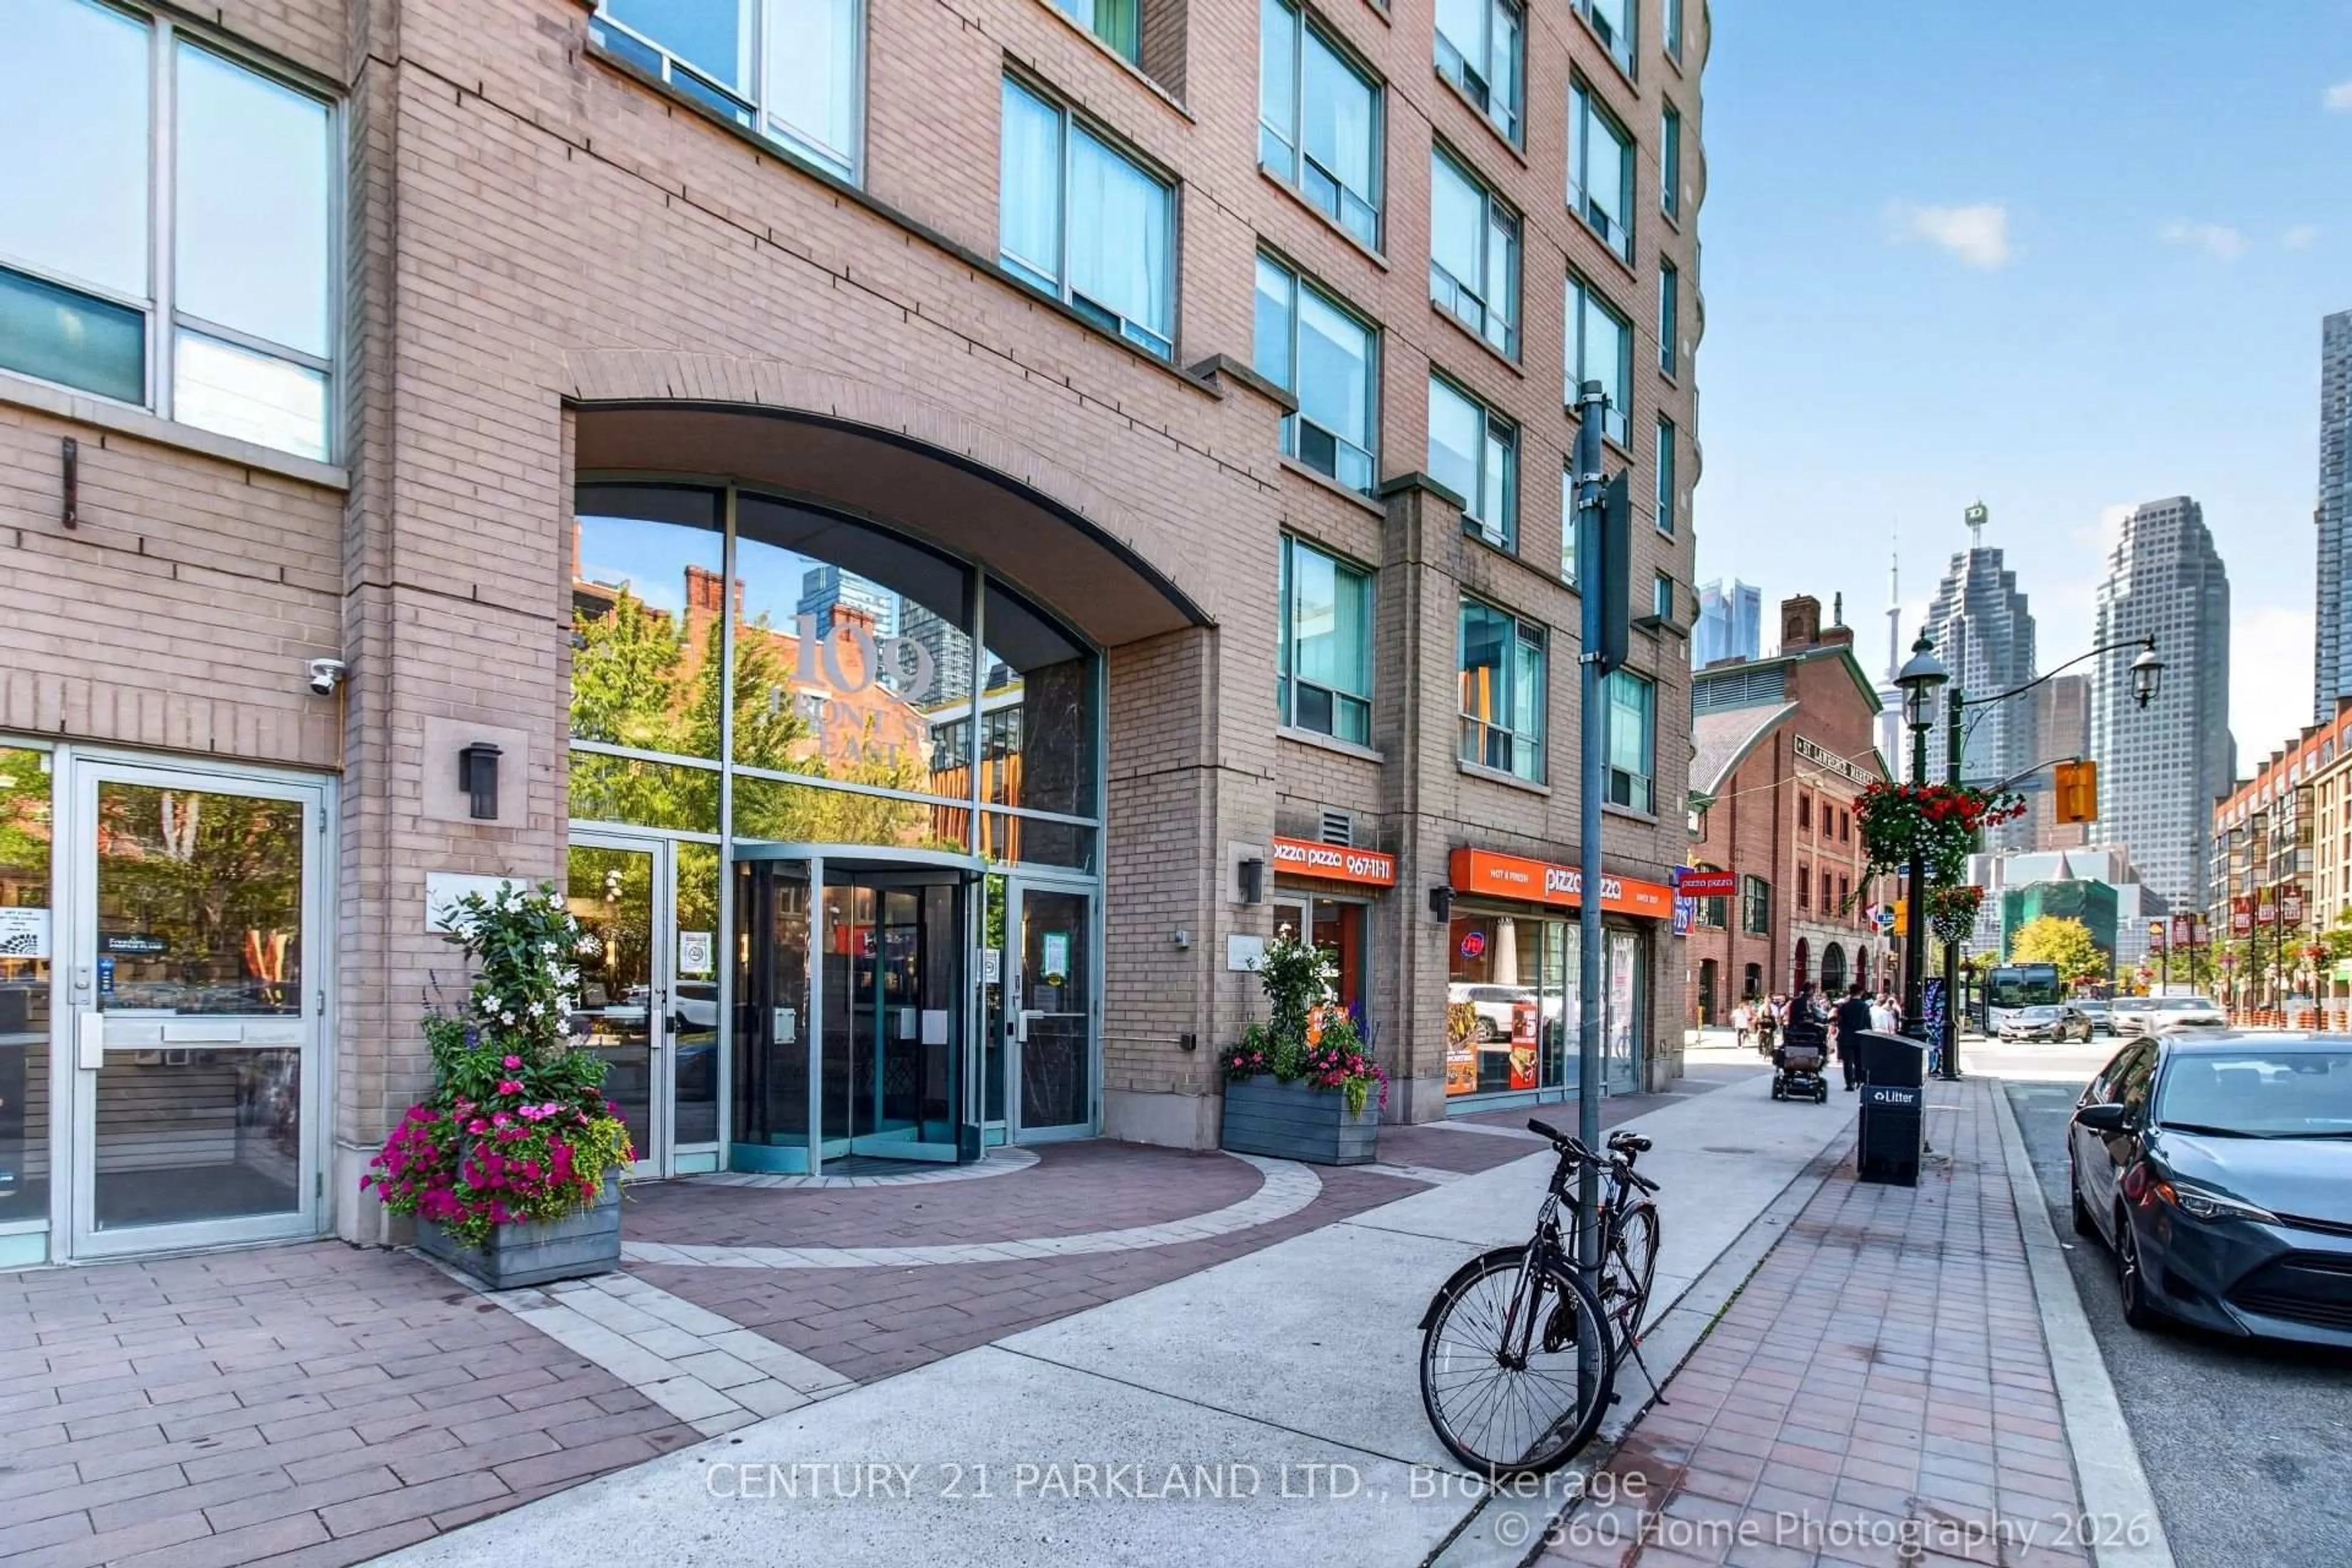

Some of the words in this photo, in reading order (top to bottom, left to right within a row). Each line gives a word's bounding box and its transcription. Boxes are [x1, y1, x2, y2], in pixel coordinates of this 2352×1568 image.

[788, 612, 935, 704] 109
[771, 685, 894, 734] FRONT
[820, 730, 903, 769] EAST
[1308, 848, 1343, 869] pizza
[1682, 880, 1706, 890] pizza
[1707, 878, 1733, 890] pizza
[1886, 1089, 1914, 1103] Litter
